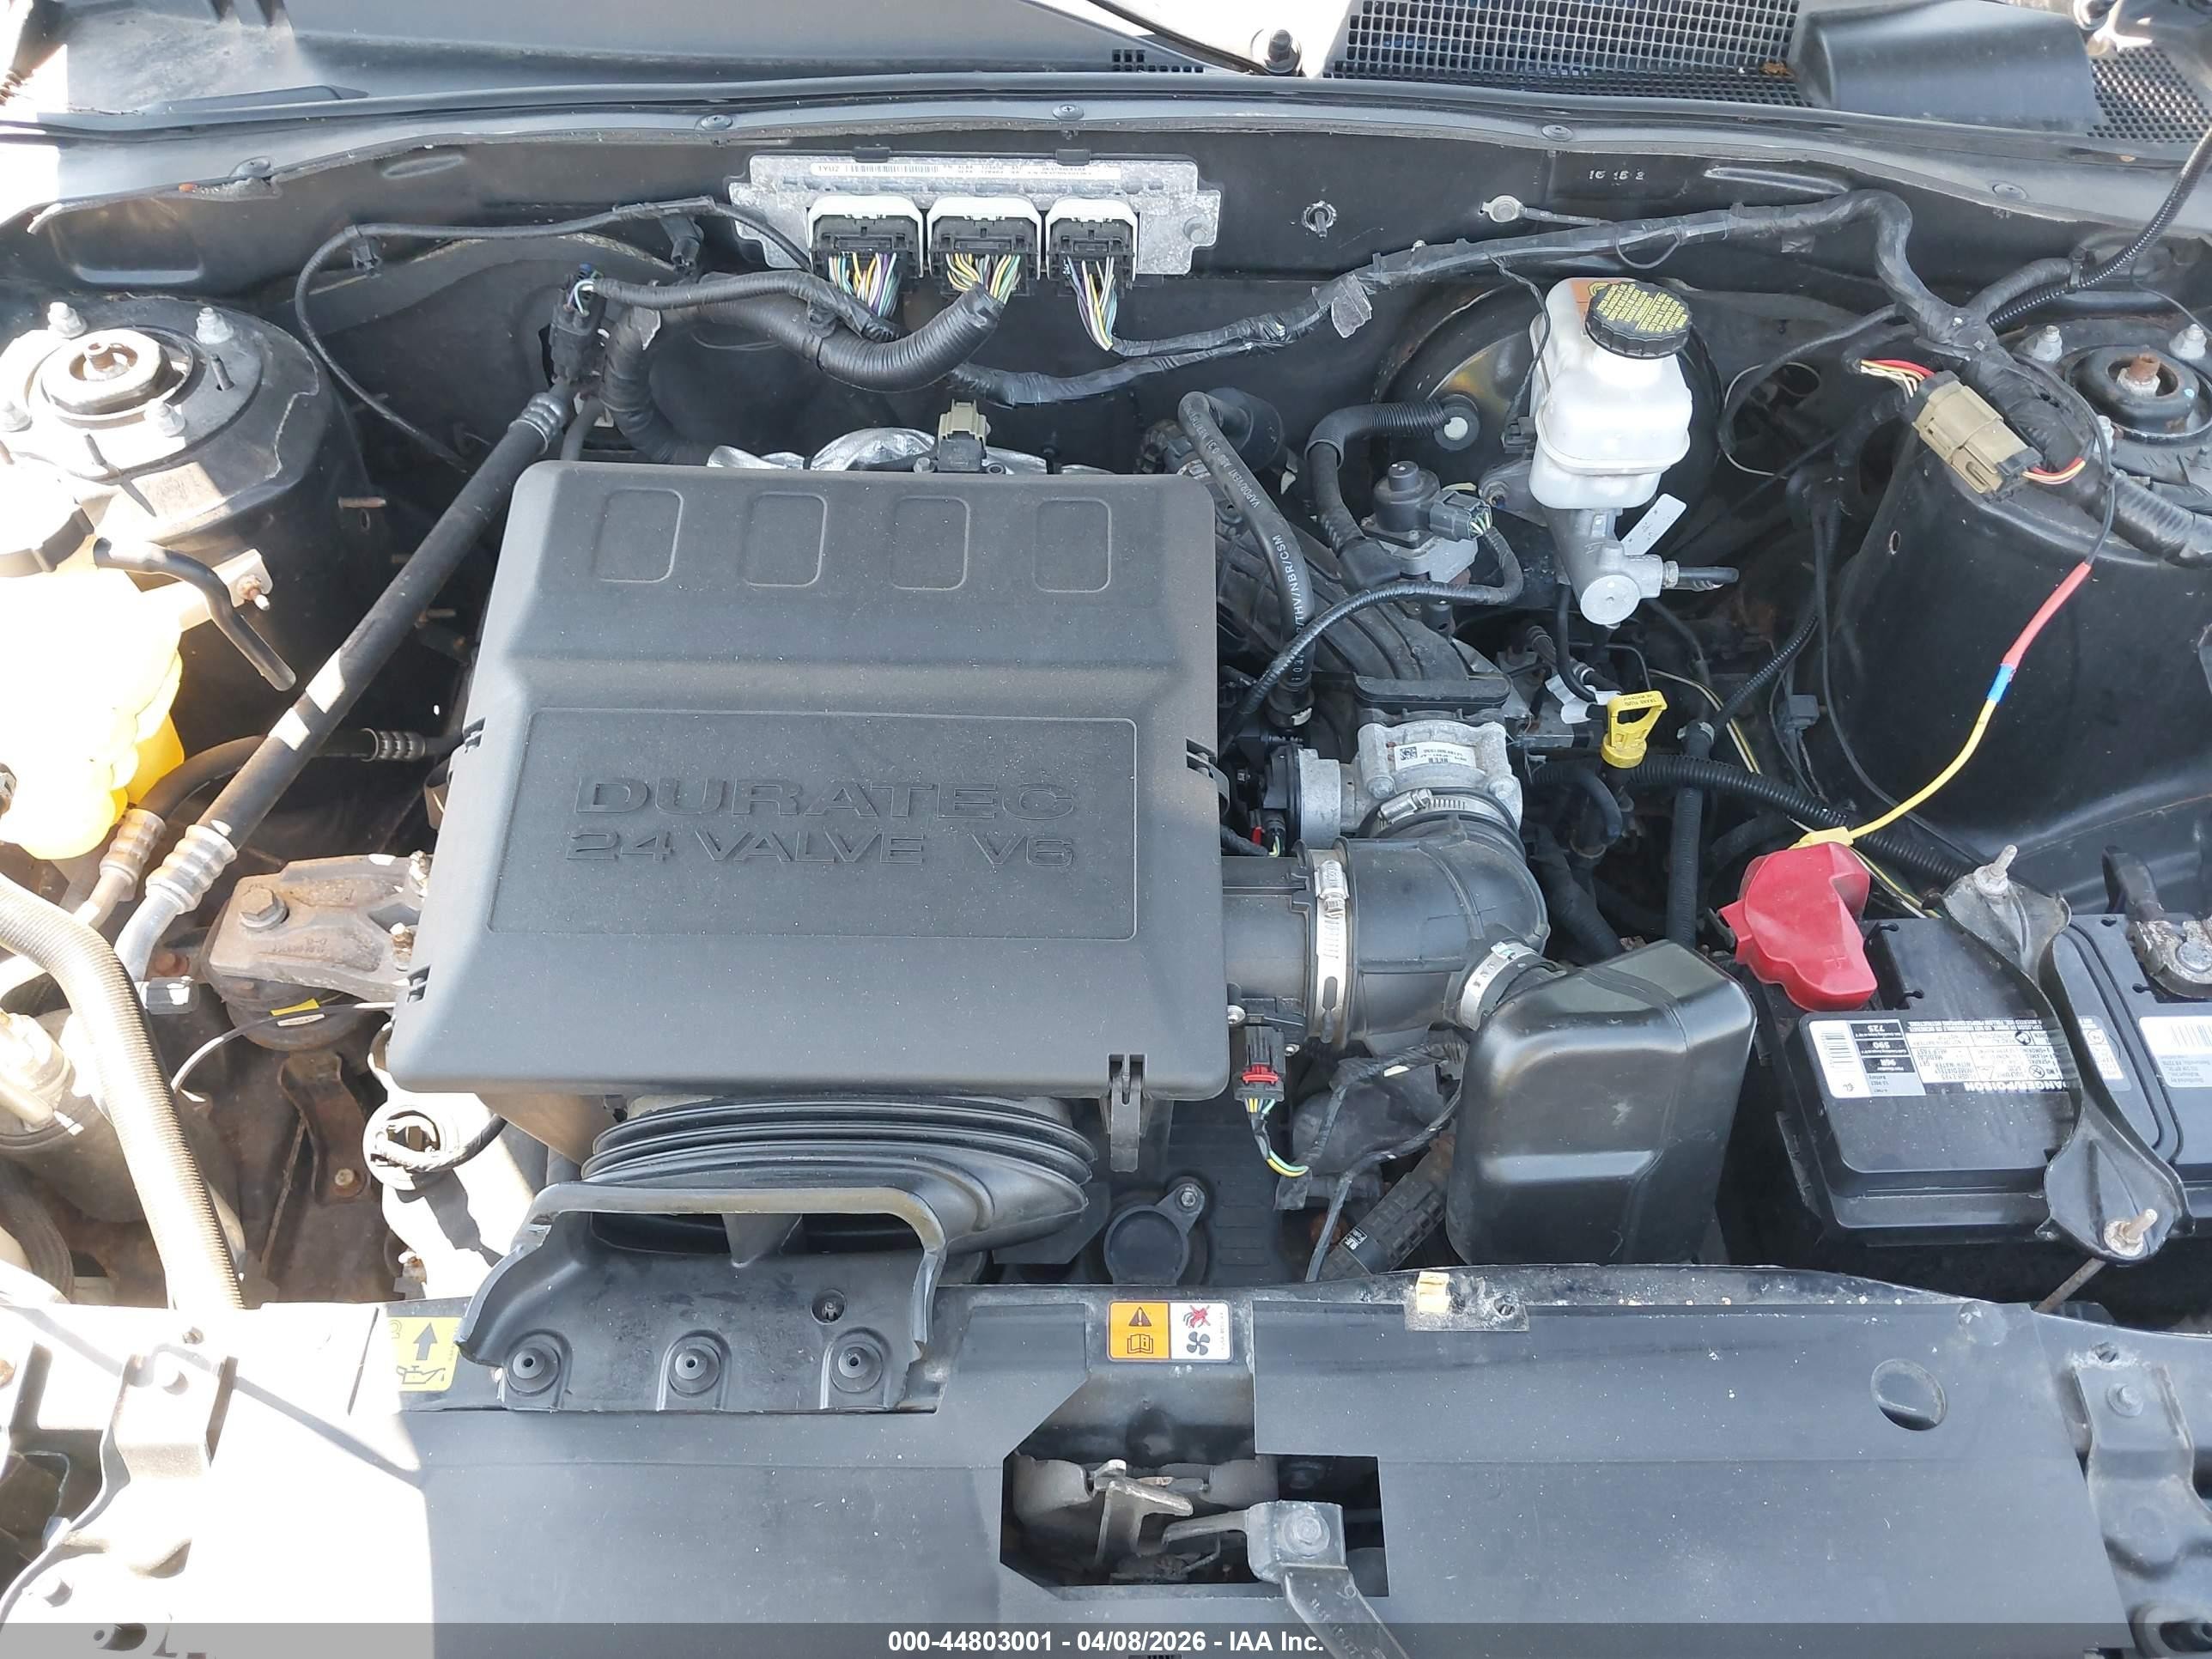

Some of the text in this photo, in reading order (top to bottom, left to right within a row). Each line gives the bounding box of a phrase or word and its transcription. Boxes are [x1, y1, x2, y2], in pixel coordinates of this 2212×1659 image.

[574, 777, 1076, 821] DURATEC
[567, 830, 1074, 866] 24 VALVE V6
[1867, 1024, 1886, 1033] 725
